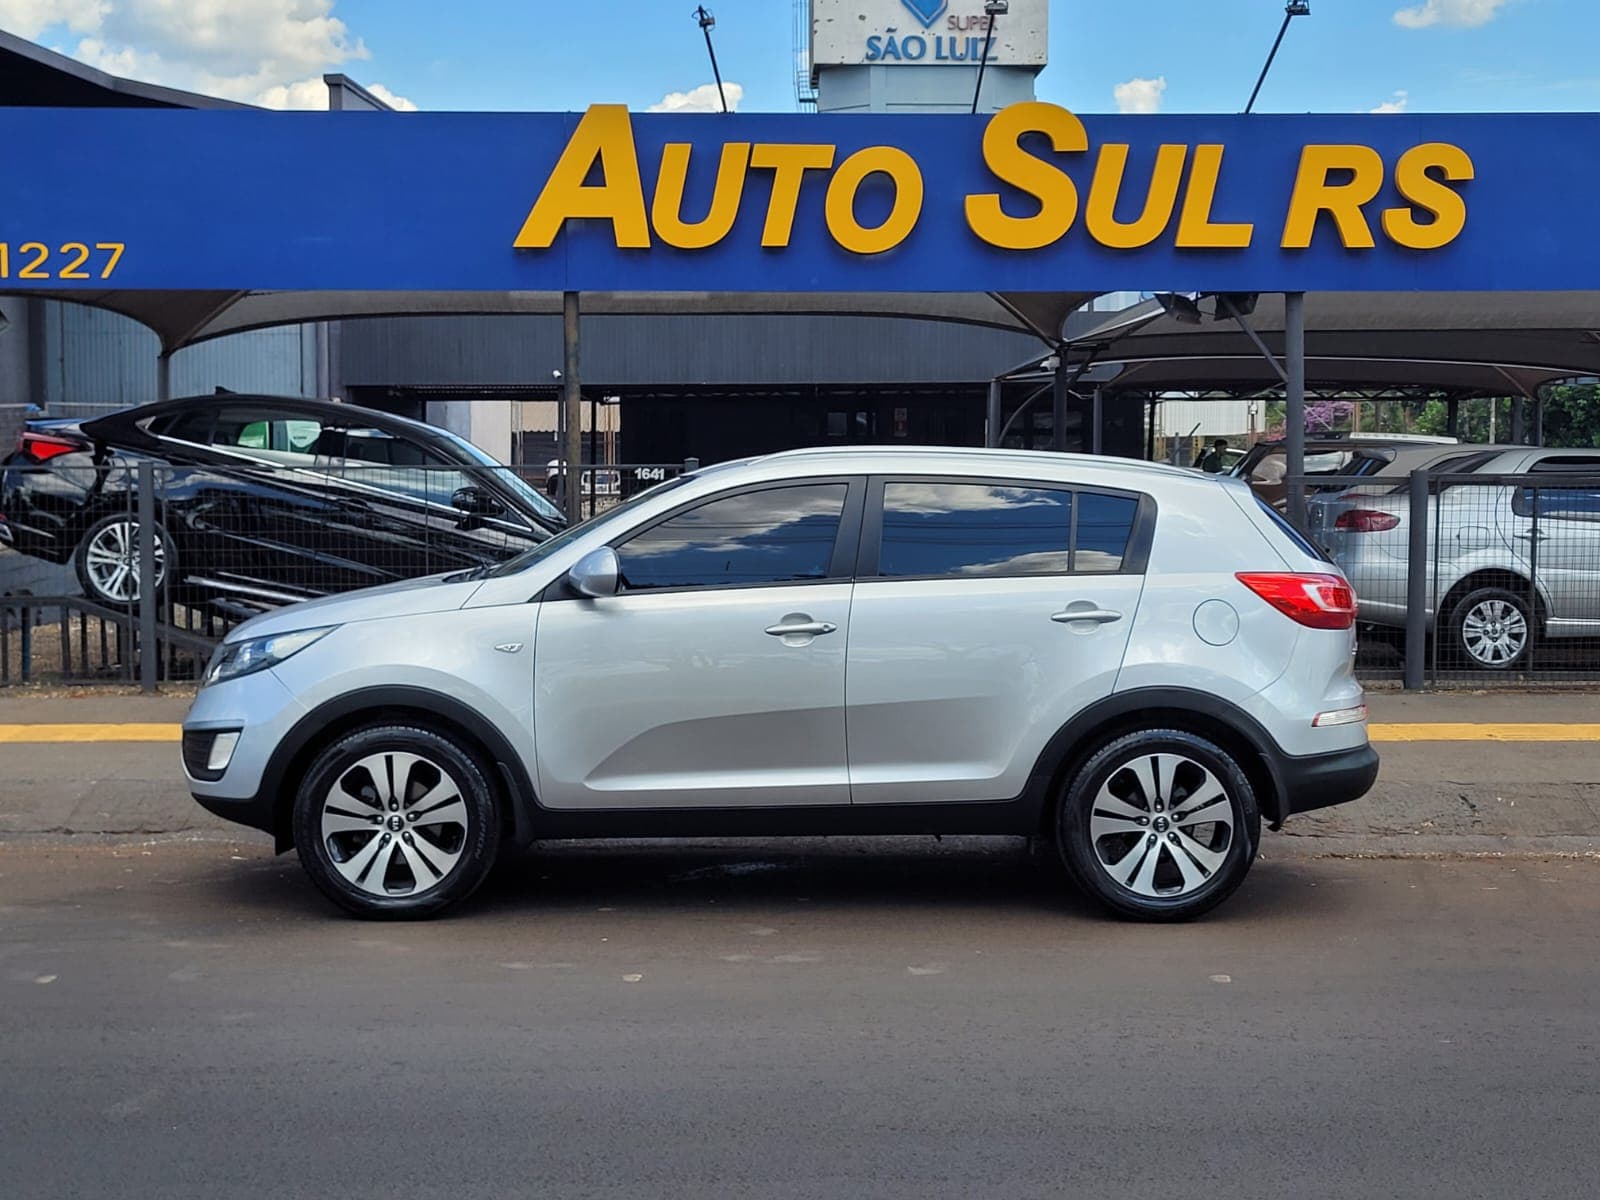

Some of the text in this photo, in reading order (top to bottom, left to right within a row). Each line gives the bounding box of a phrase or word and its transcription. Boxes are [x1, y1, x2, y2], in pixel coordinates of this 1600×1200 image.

[947, 15, 998, 30] SUPE
[866, 27, 927, 61] SÃO
[513, 101, 1475, 254] AUTO SUL RS
[634, 467, 665, 480] 1641
